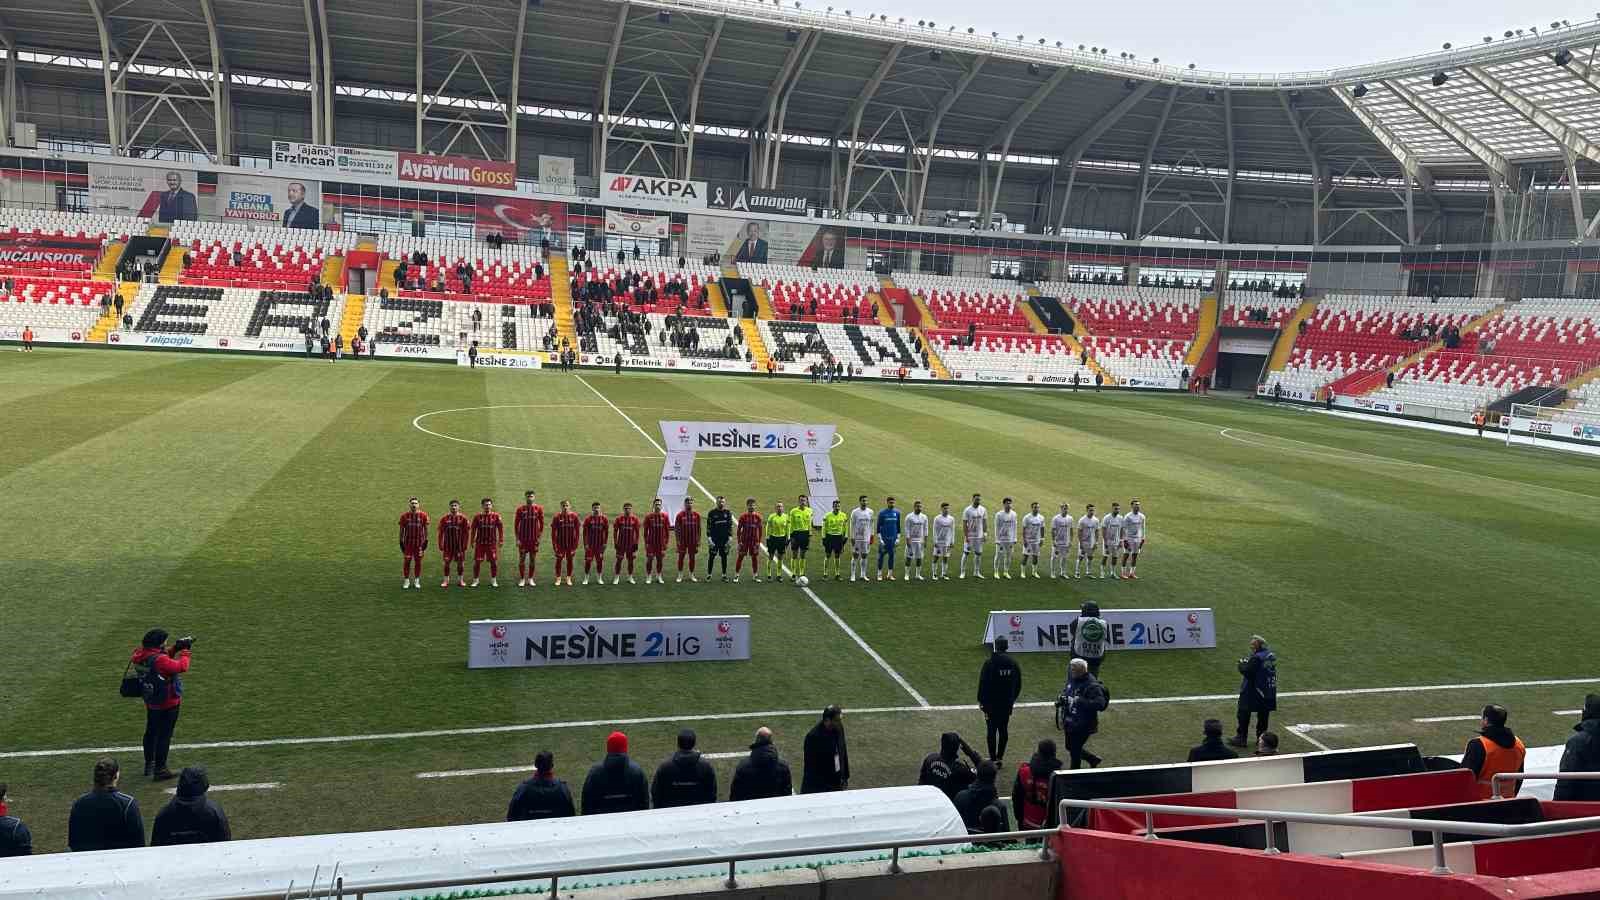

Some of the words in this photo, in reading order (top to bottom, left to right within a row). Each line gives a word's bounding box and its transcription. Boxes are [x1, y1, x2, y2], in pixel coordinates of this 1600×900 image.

[301, 145, 329, 156] ajans
[401, 160, 470, 181] Ayaydın
[471, 166, 513, 185] Gross
[632, 179, 697, 199] AKPA
[234, 192, 266, 203] SPORU
[750, 196, 807, 210] anagold
[231, 201, 271, 211] TABANA
[226, 209, 278, 220] YAYIYORUZ
[403, 346, 428, 355] AKPA
[631, 358, 662, 367] Elektrik
[698, 428, 761, 449] NESİNE
[525, 625, 636, 661] NESİNE
